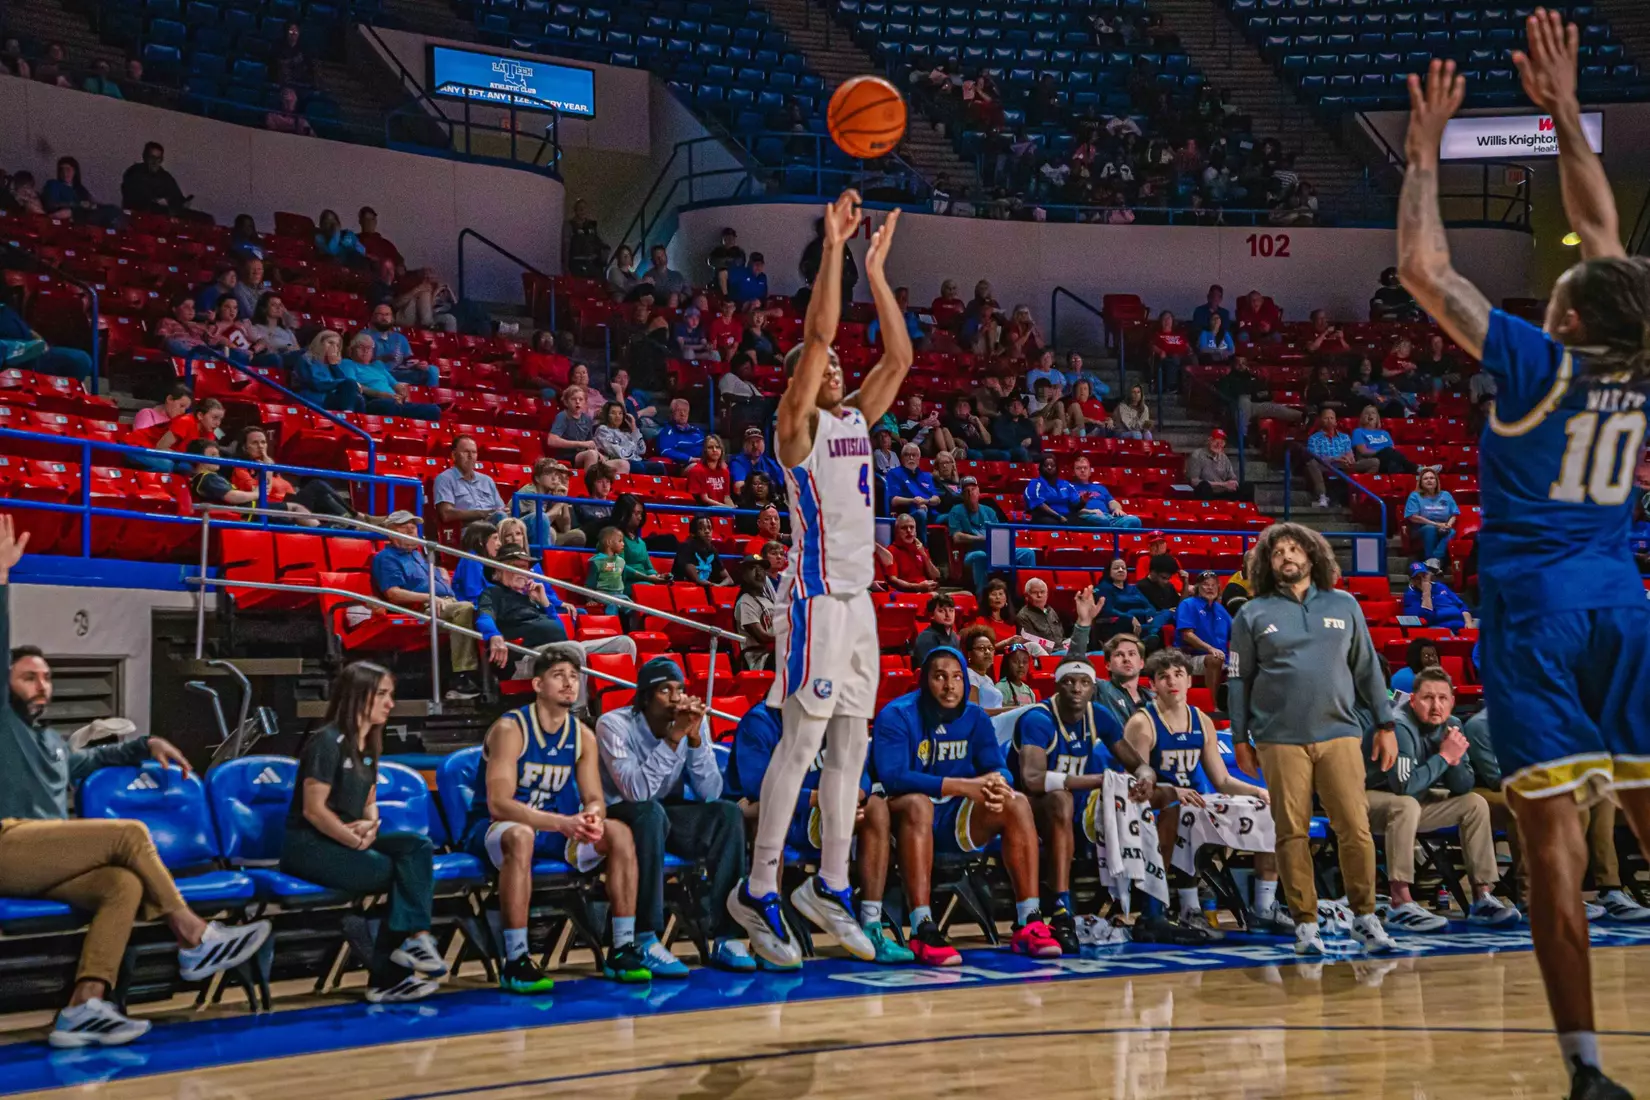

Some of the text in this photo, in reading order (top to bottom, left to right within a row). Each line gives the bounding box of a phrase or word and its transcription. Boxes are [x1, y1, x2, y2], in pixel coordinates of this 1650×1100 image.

[490, 82, 537, 95] ATHLETIC CLUB
[487, 91, 506, 101] ANY
[563, 102, 589, 113] YEAR.
[1477, 136, 1507, 147] Willis
[1245, 234, 1290, 258] 102
[1548, 411, 1648, 506] 10
[857, 463, 871, 508] 4
[1323, 617, 1346, 630] FIU
[937, 740, 968, 761] FIU
[1160, 749, 1201, 773] FIU
[518, 761, 572, 792] FIU
